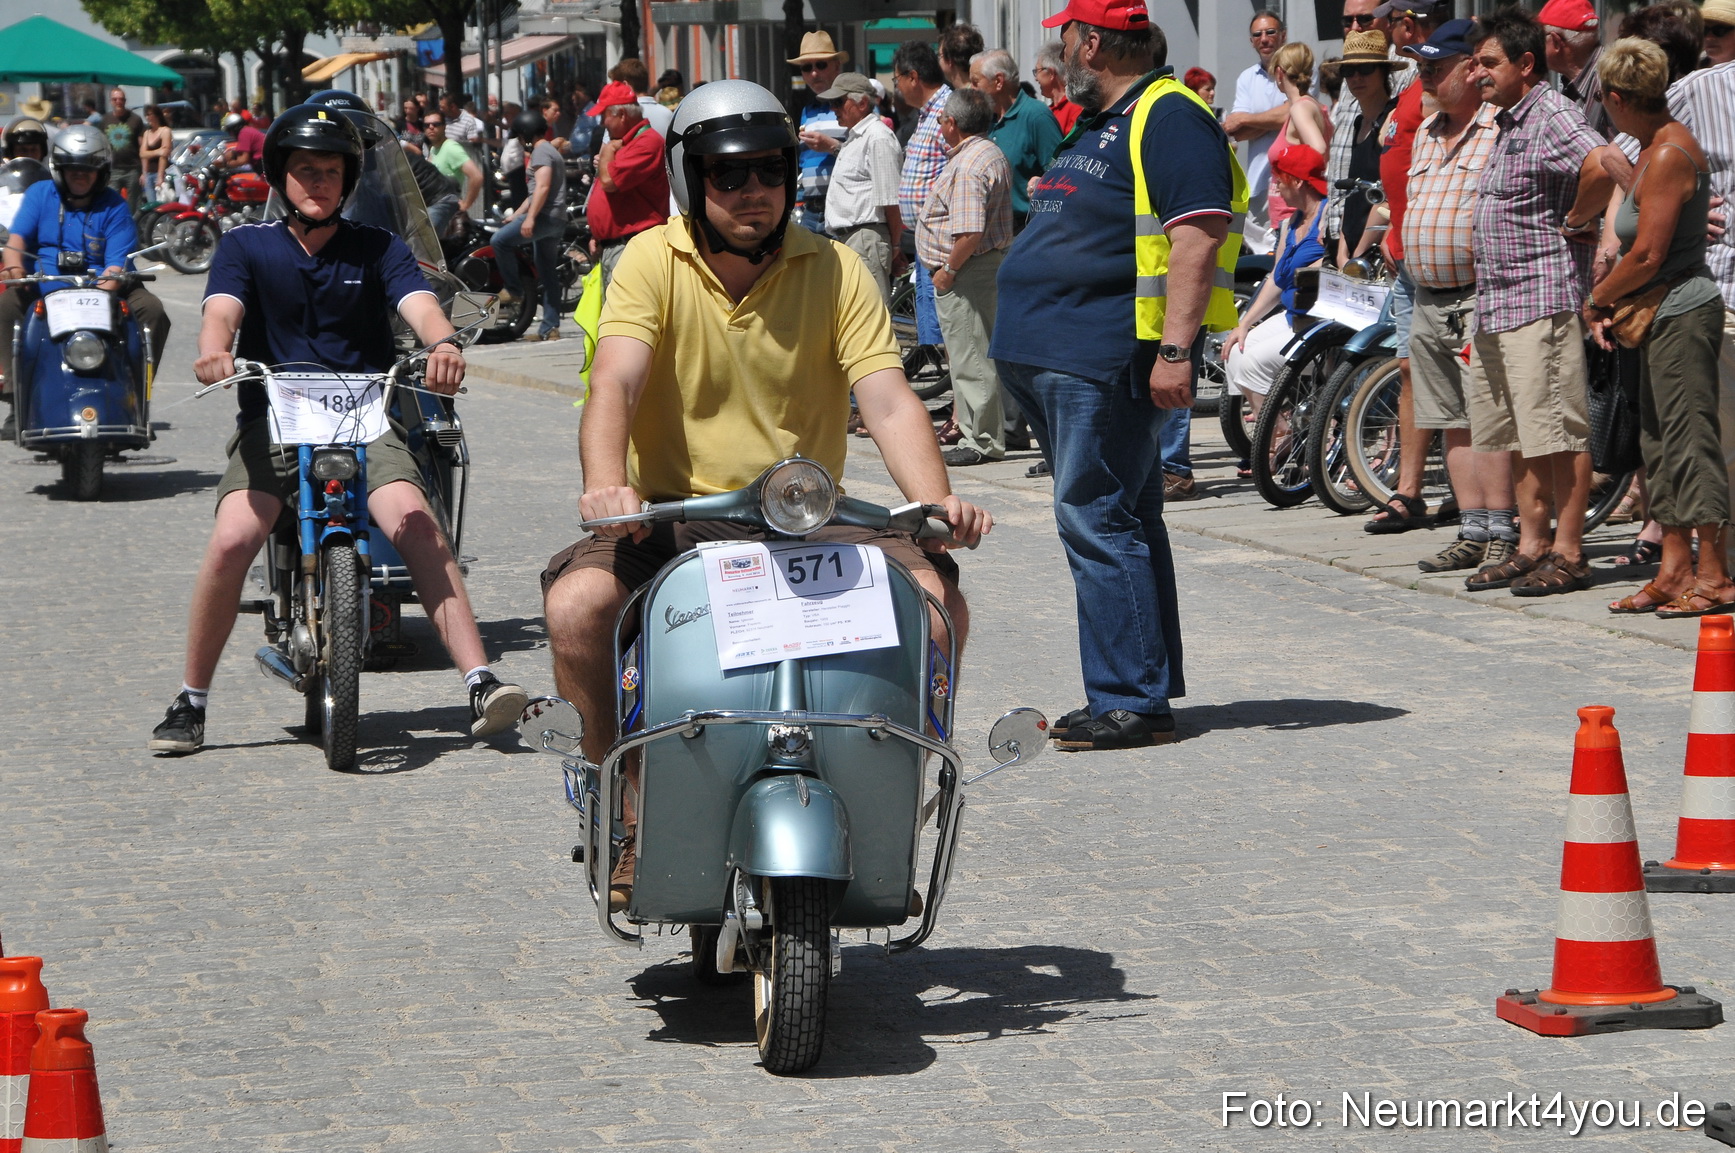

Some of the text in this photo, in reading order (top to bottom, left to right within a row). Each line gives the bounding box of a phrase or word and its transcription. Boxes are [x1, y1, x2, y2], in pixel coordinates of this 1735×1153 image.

[324, 99, 350, 107] uvex
[1100, 131, 1118, 142] CREW
[76, 298, 99, 306] 472
[1351, 291, 1375, 306] 515
[319, 394, 356, 413] 188
[788, 551, 843, 584] 571
